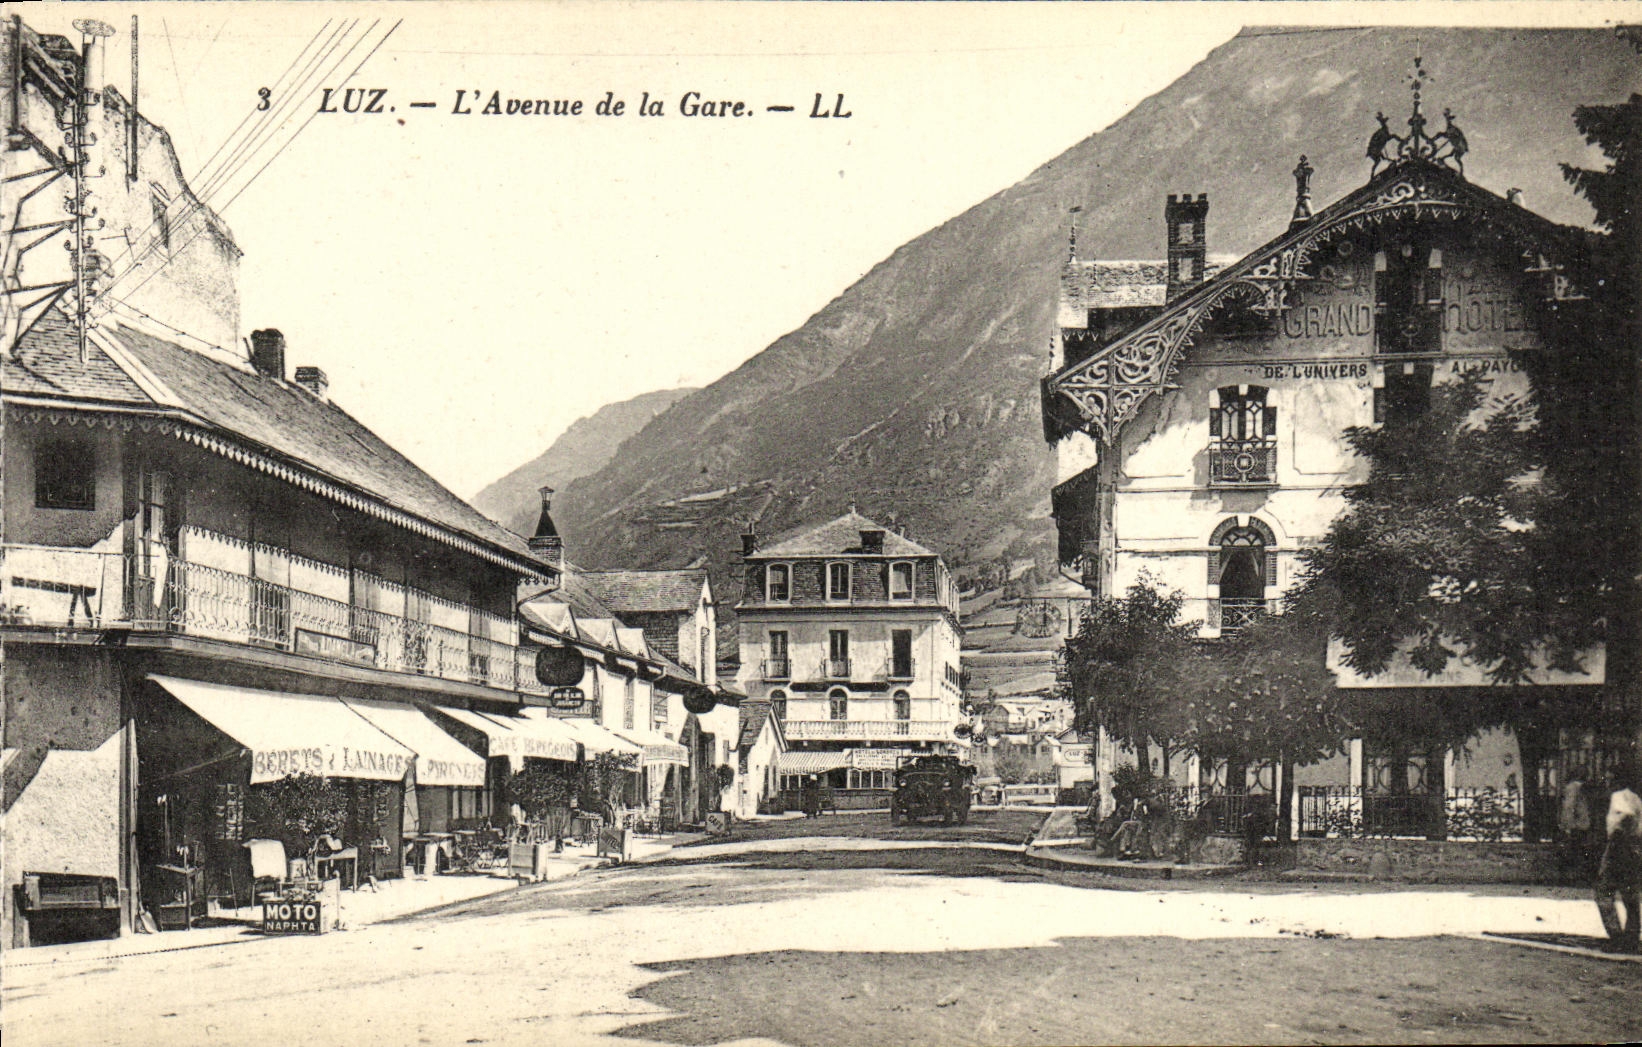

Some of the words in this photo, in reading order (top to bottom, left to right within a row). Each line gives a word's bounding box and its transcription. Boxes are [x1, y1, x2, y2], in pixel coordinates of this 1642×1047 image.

[1283, 302, 1374, 339] GRAND
[266, 903, 317, 921] MOTO
[266, 921, 316, 932] NAPHTA
